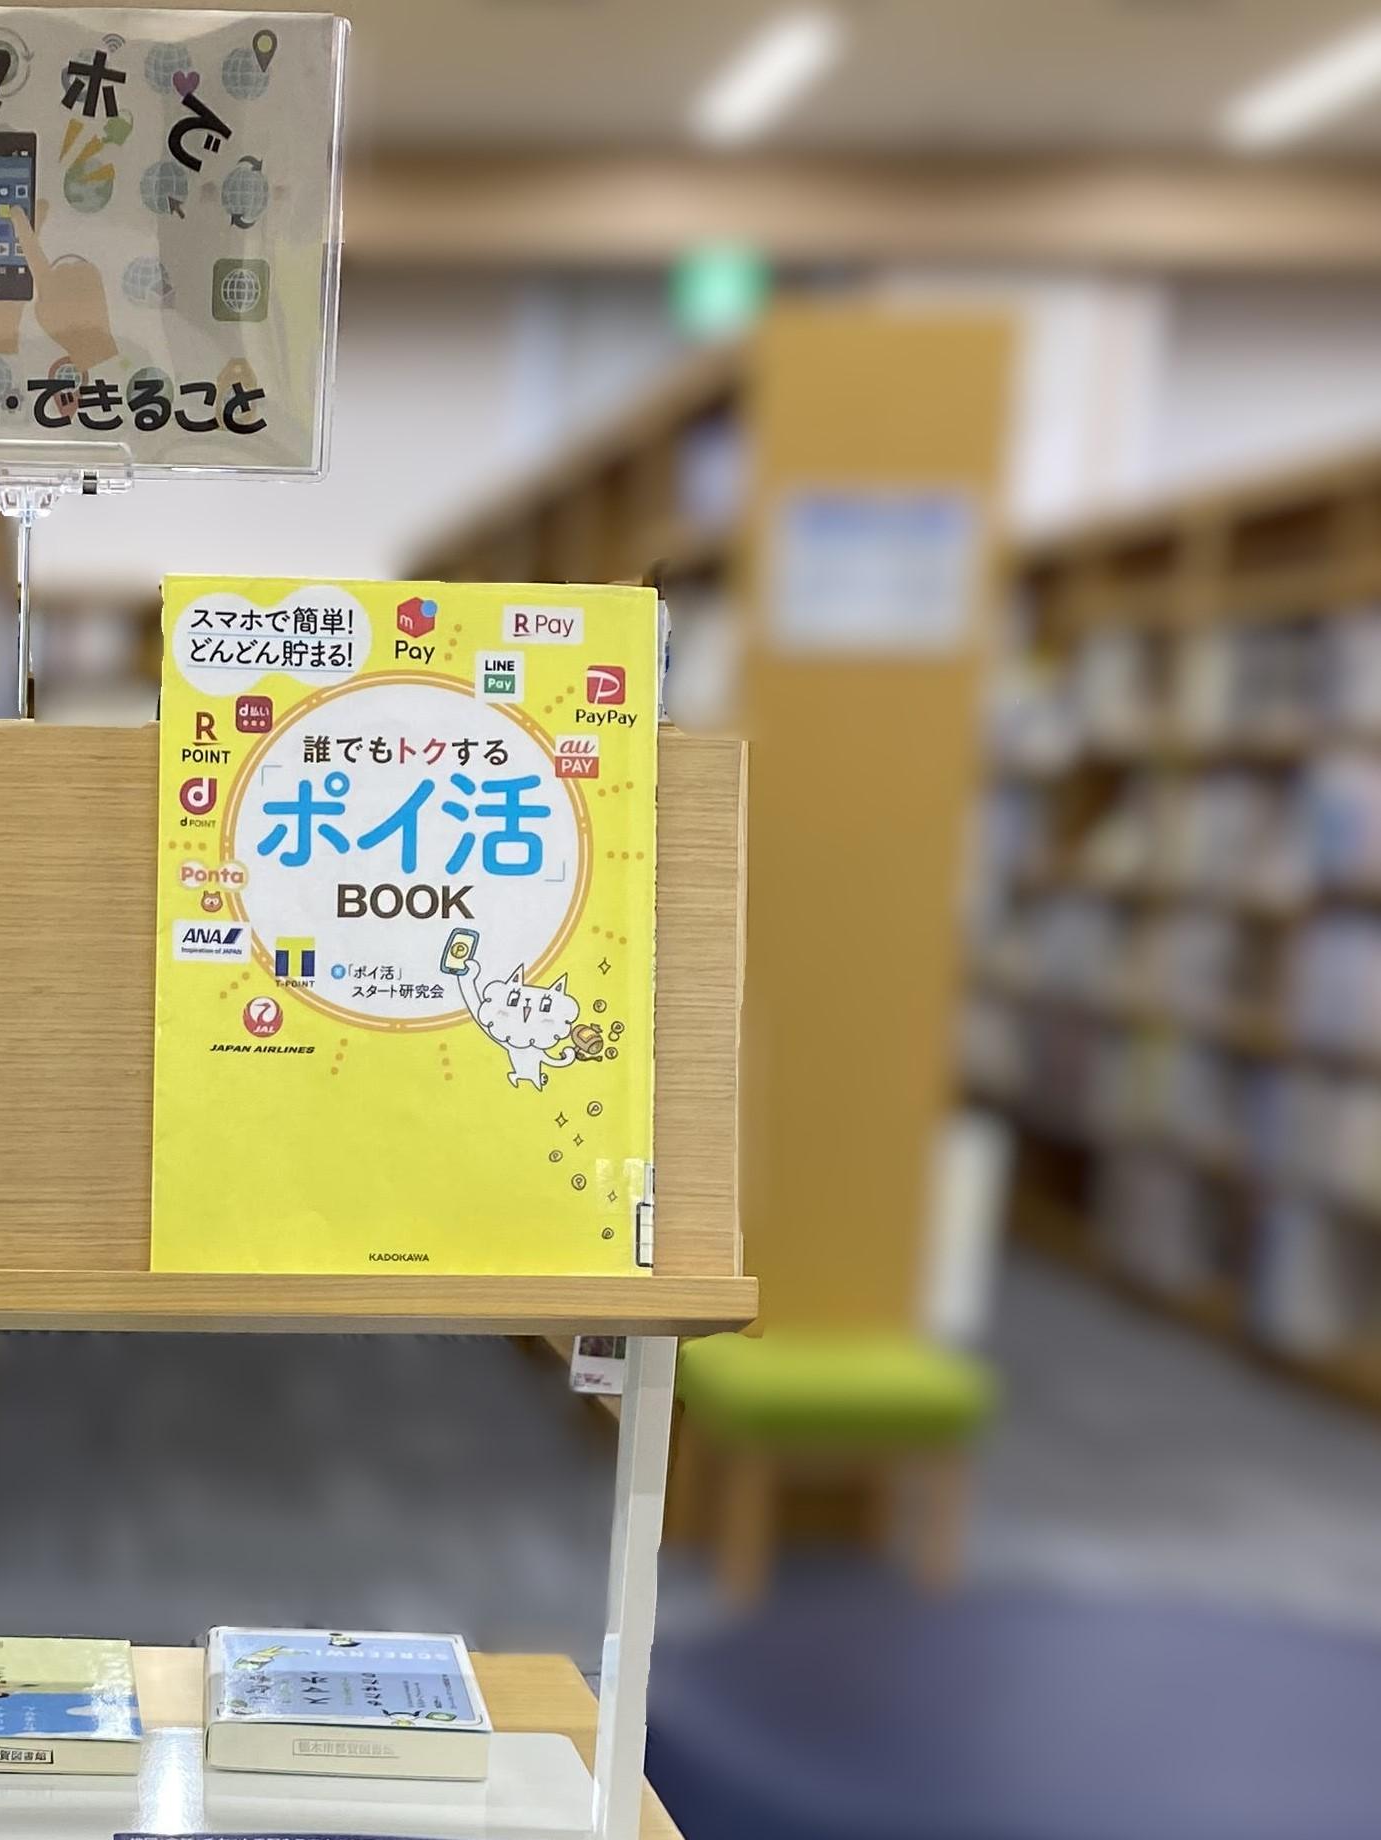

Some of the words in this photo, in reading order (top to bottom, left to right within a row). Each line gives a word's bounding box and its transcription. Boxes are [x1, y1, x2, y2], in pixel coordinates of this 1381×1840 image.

[190, 605, 354, 637] スマホで簡単!
[513, 613, 531, 637] R
[535, 614, 574, 637] Pay
[189, 639, 354, 668] どんどん貯まる!
[395, 640, 435, 664] Pay
[485, 660, 515, 671] LINE
[488, 678, 512, 692] Pay
[239, 704, 269, 717] d払い
[575, 709, 637, 728] PayPay
[194, 711, 219, 744] R
[303, 735, 509, 766] 誰でもトクする
[560, 739, 594, 754] au
[182, 749, 231, 765] POINT
[561, 760, 593, 774] PAY
[181, 866, 244, 884] Ponta
[336, 883, 475, 920] BOOK
[182, 928, 221, 944] ANA
[352, 984, 444, 999] スタート研究会
[210, 1044, 251, 1052] JAPAN
[253, 1045, 315, 1054] AIRLINES
[368, 1252, 430, 1263] KADOKAWA
